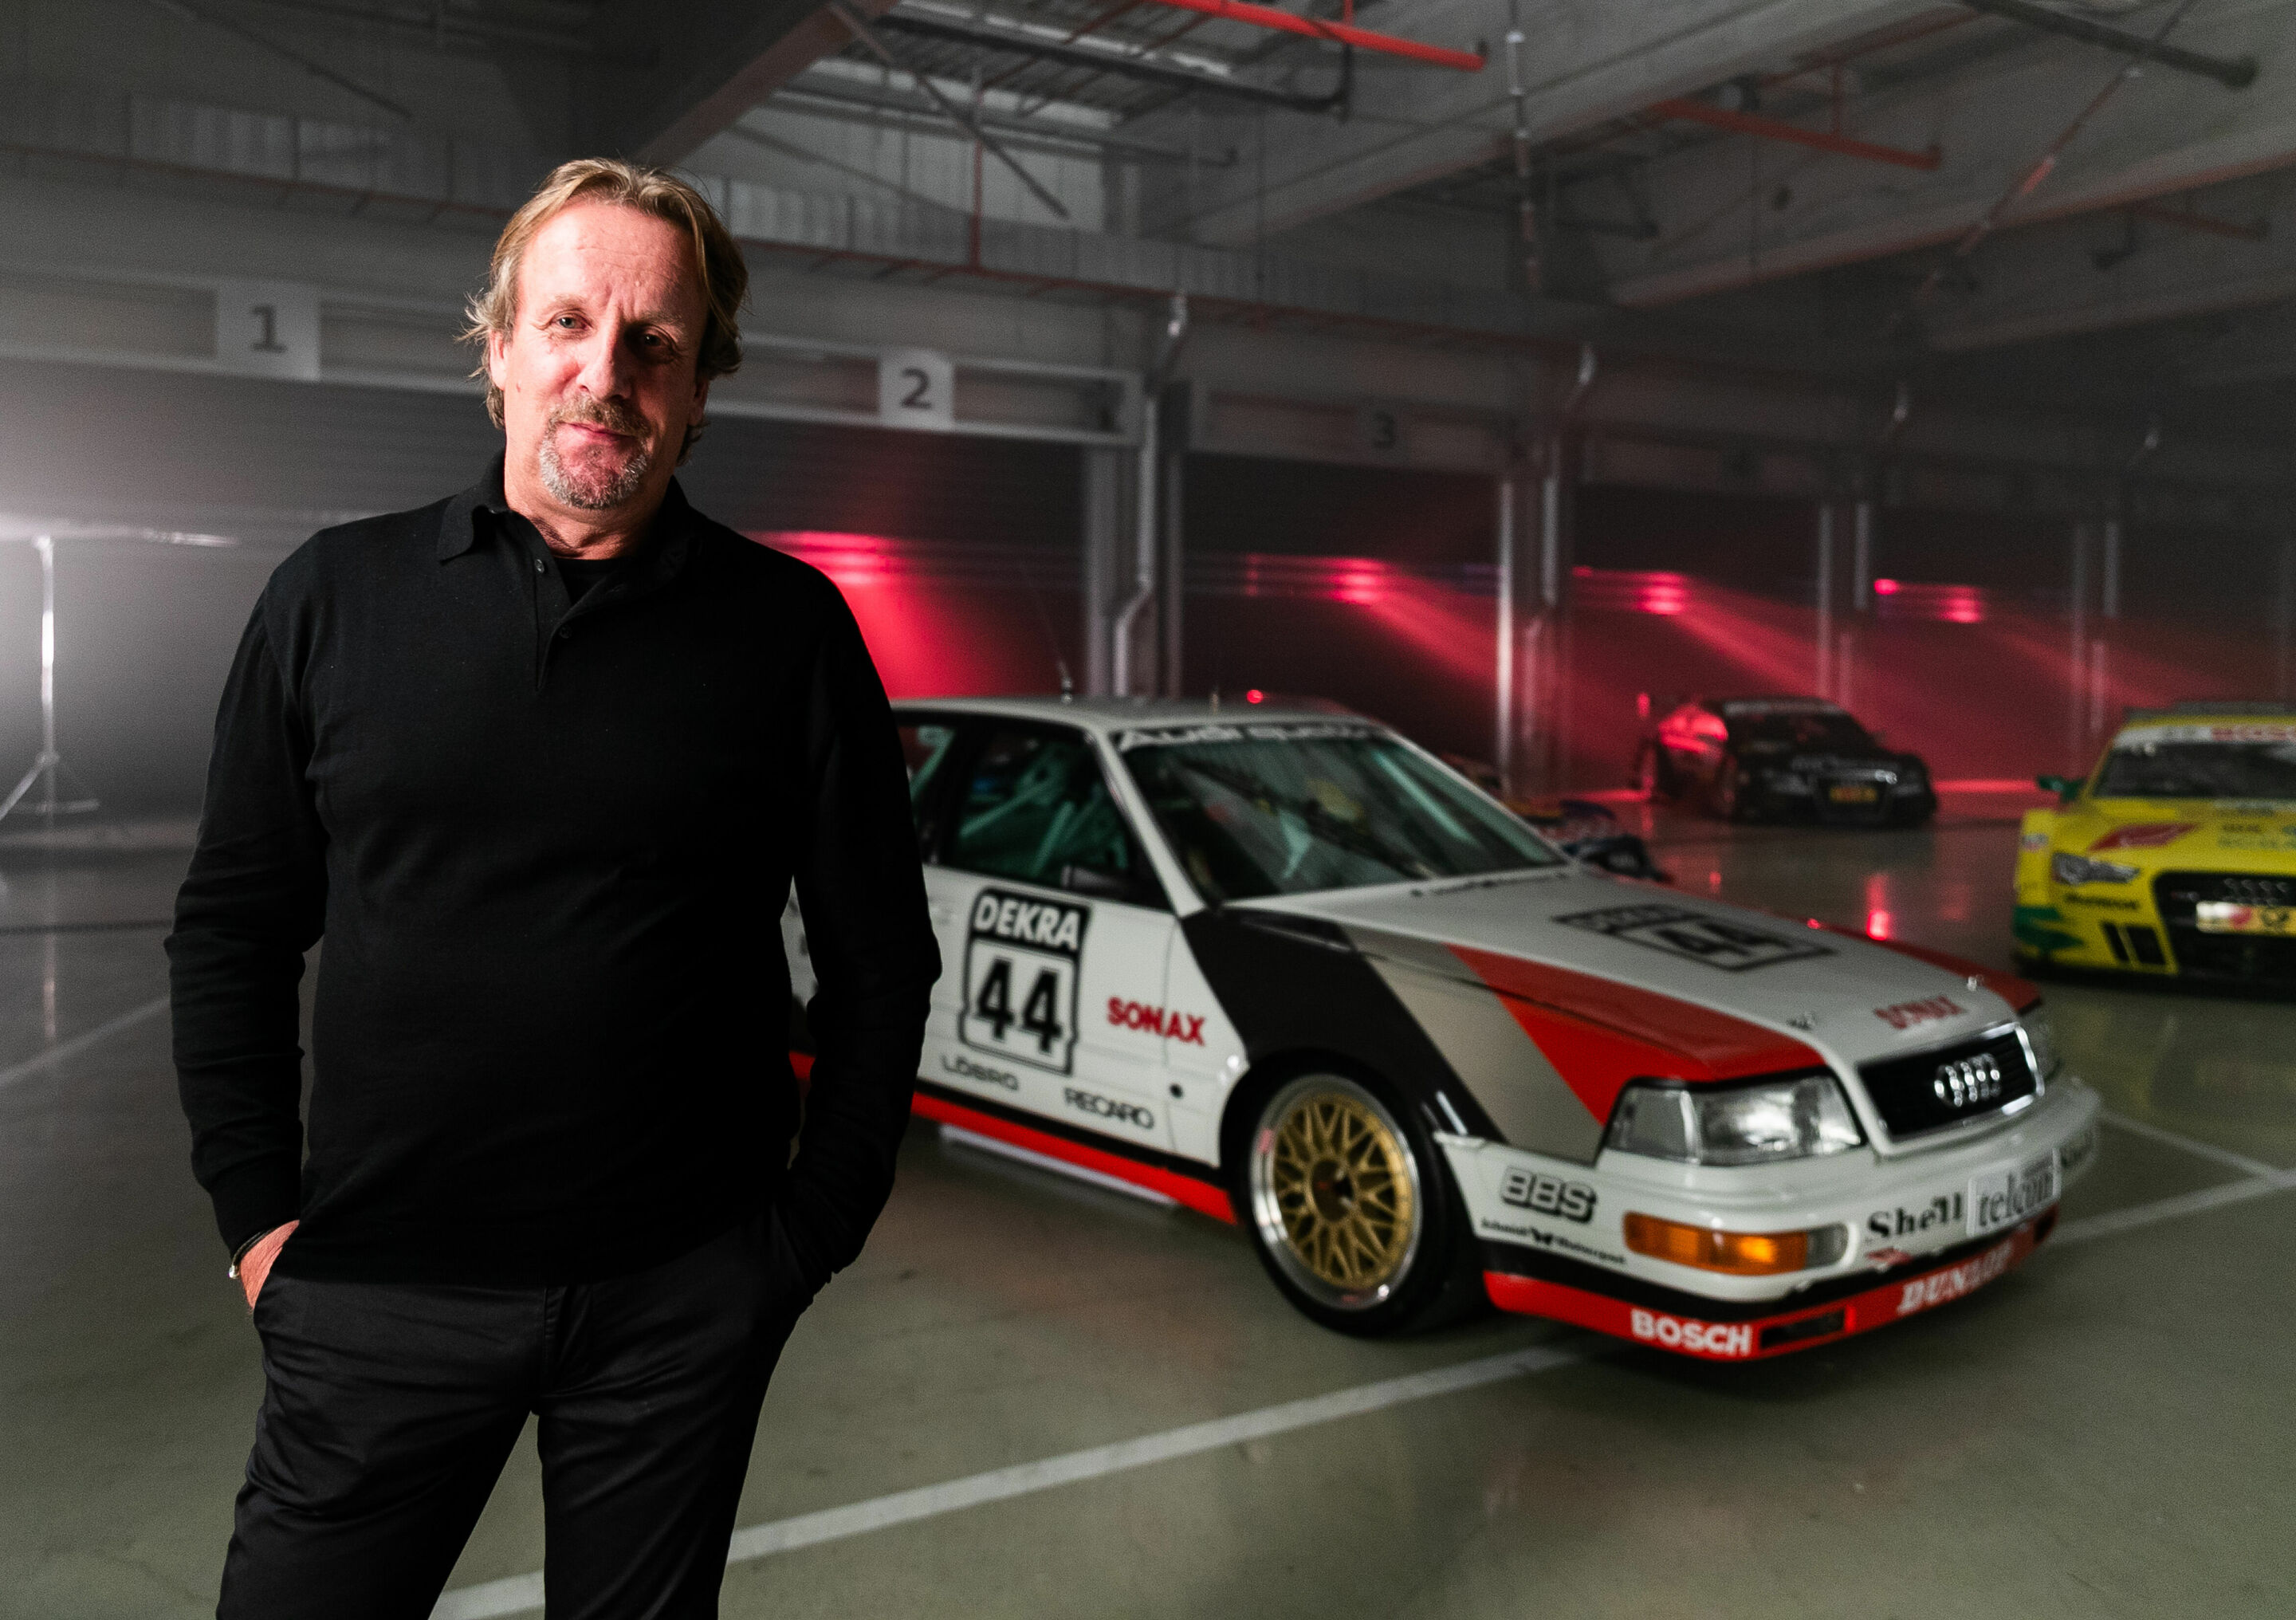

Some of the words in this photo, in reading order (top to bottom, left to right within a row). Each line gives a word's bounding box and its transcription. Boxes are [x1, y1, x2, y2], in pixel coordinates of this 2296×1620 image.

[251, 306, 287, 352] 1
[899, 369, 931, 408] 2
[1373, 413, 1396, 447] 3
[974, 896, 1080, 950] DEKRA
[976, 958, 1063, 1053] 44
[1107, 997, 1205, 1047] SONAX
[1500, 1166, 1597, 1224] BBS
[1866, 1192, 1962, 1237] Shell
[1631, 1307, 1752, 1357] BOSCH
